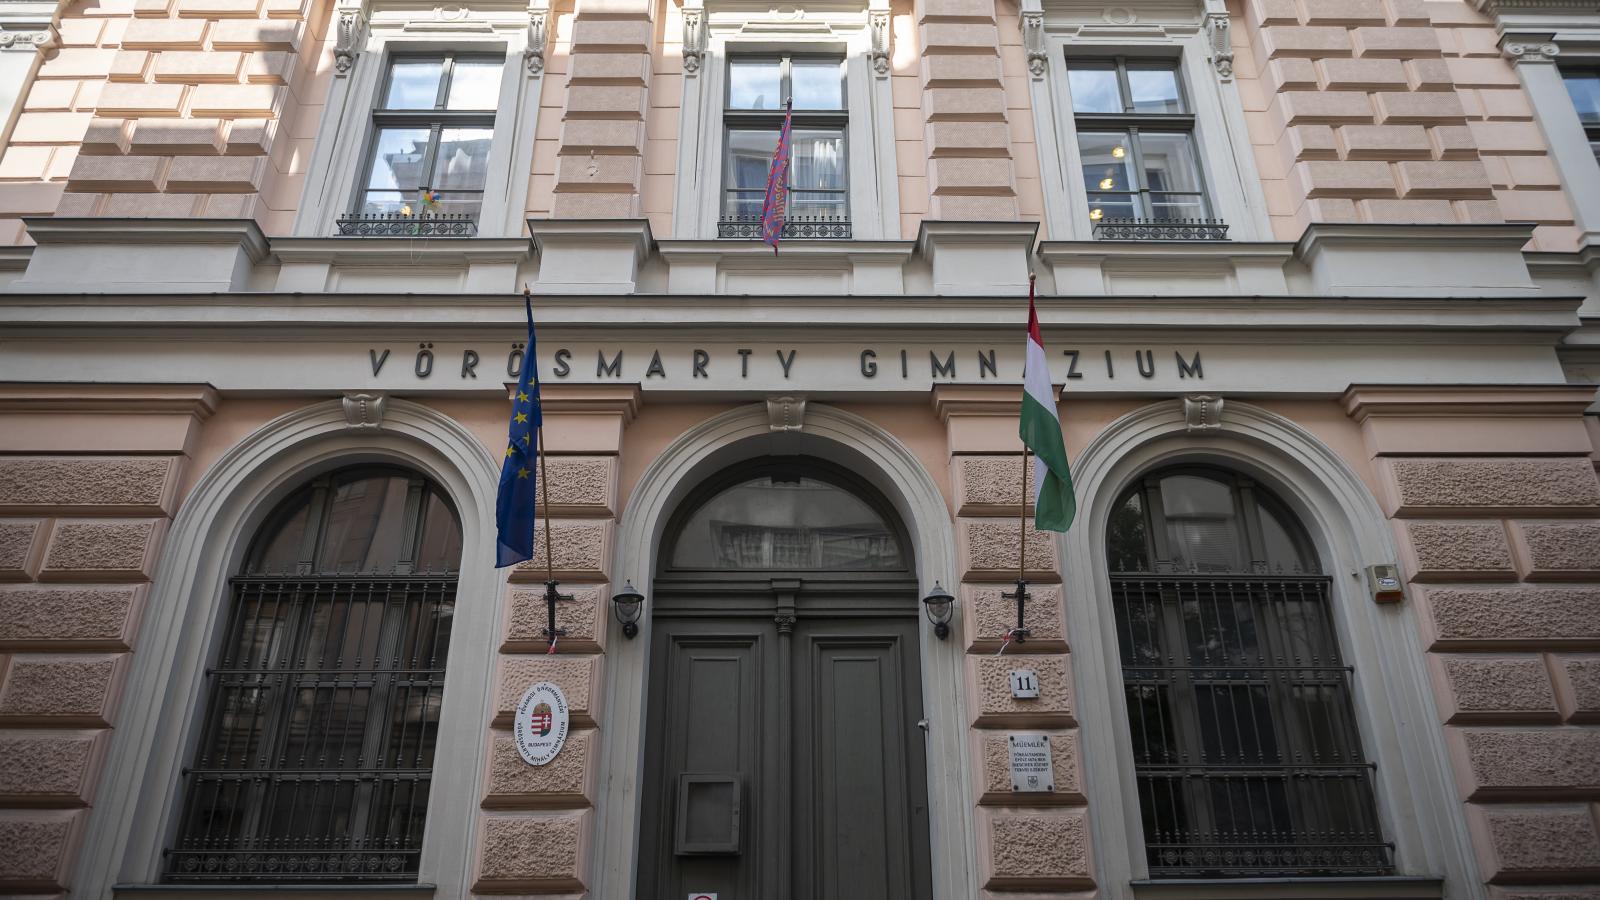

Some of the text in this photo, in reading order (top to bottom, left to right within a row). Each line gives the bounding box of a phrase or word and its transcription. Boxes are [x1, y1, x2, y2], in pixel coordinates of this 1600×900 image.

[369, 343, 1203, 378] VÖRÖSMARTY GIMNZIUM
[1017, 676, 1036, 690] 11.
